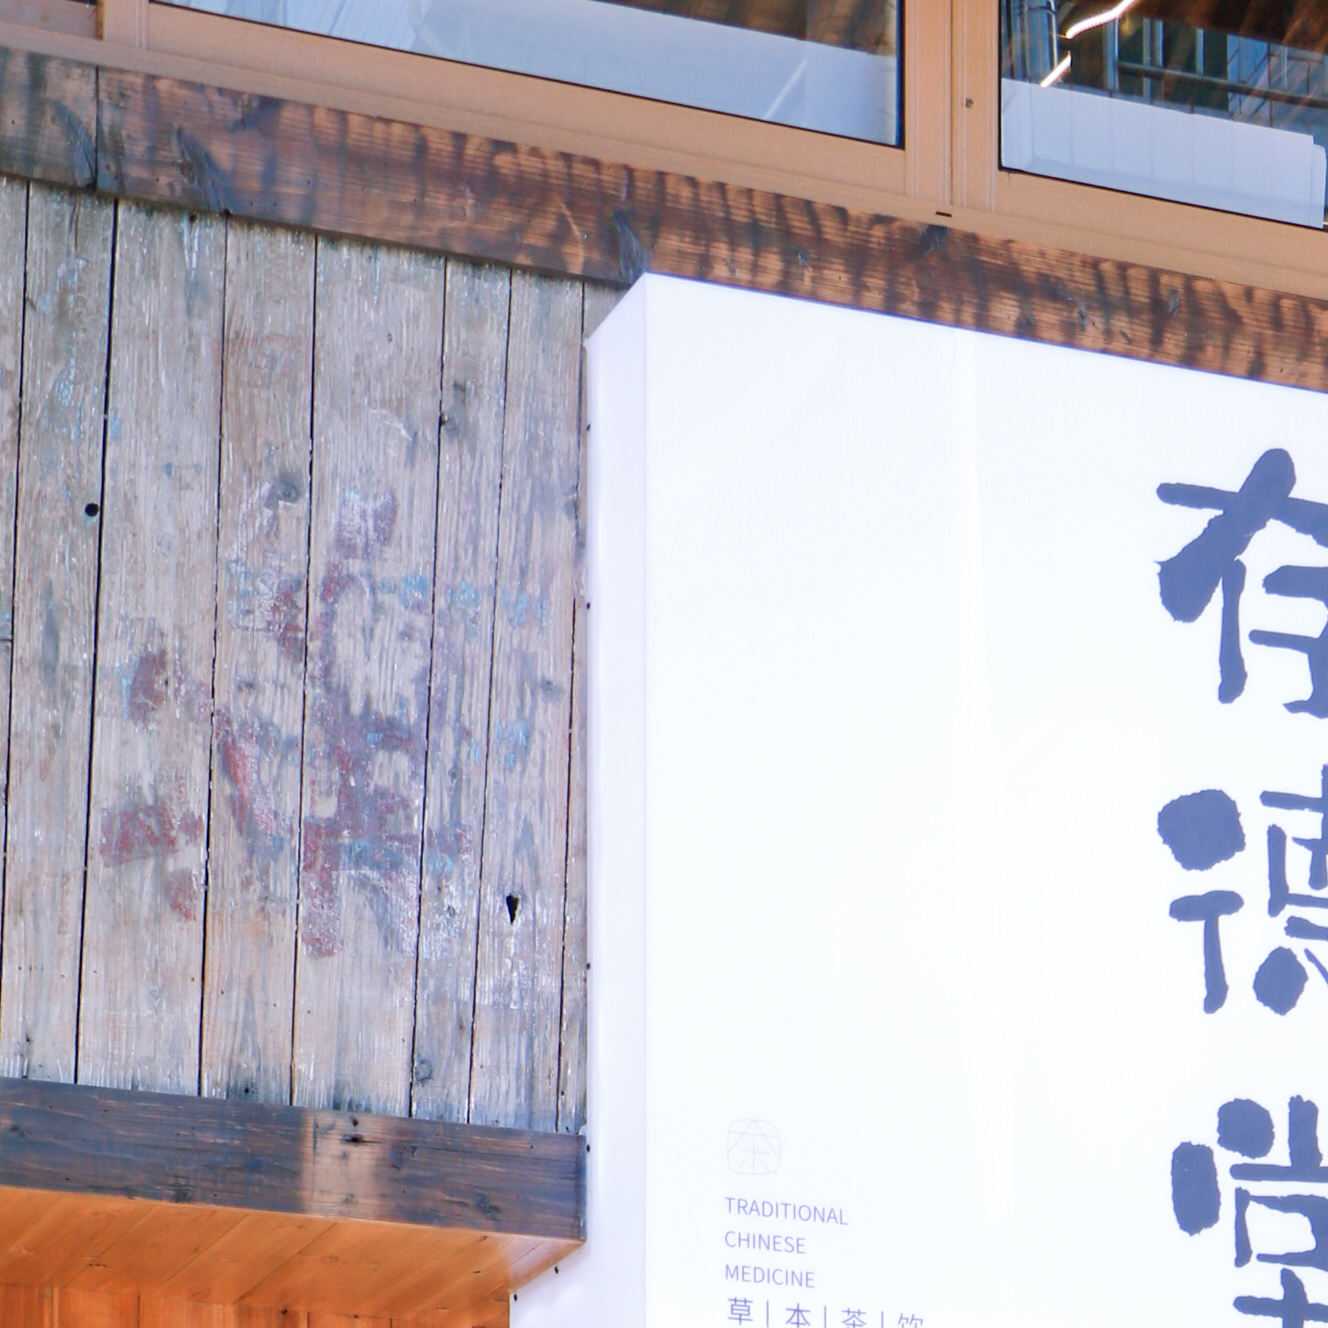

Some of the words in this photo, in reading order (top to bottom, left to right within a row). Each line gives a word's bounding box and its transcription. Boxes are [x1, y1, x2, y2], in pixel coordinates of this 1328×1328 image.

[724, 1196, 849, 1226] TRADITIONAL
[724, 1230, 807, 1255] CHINESE
[724, 1263, 816, 1289] MEDICINE
